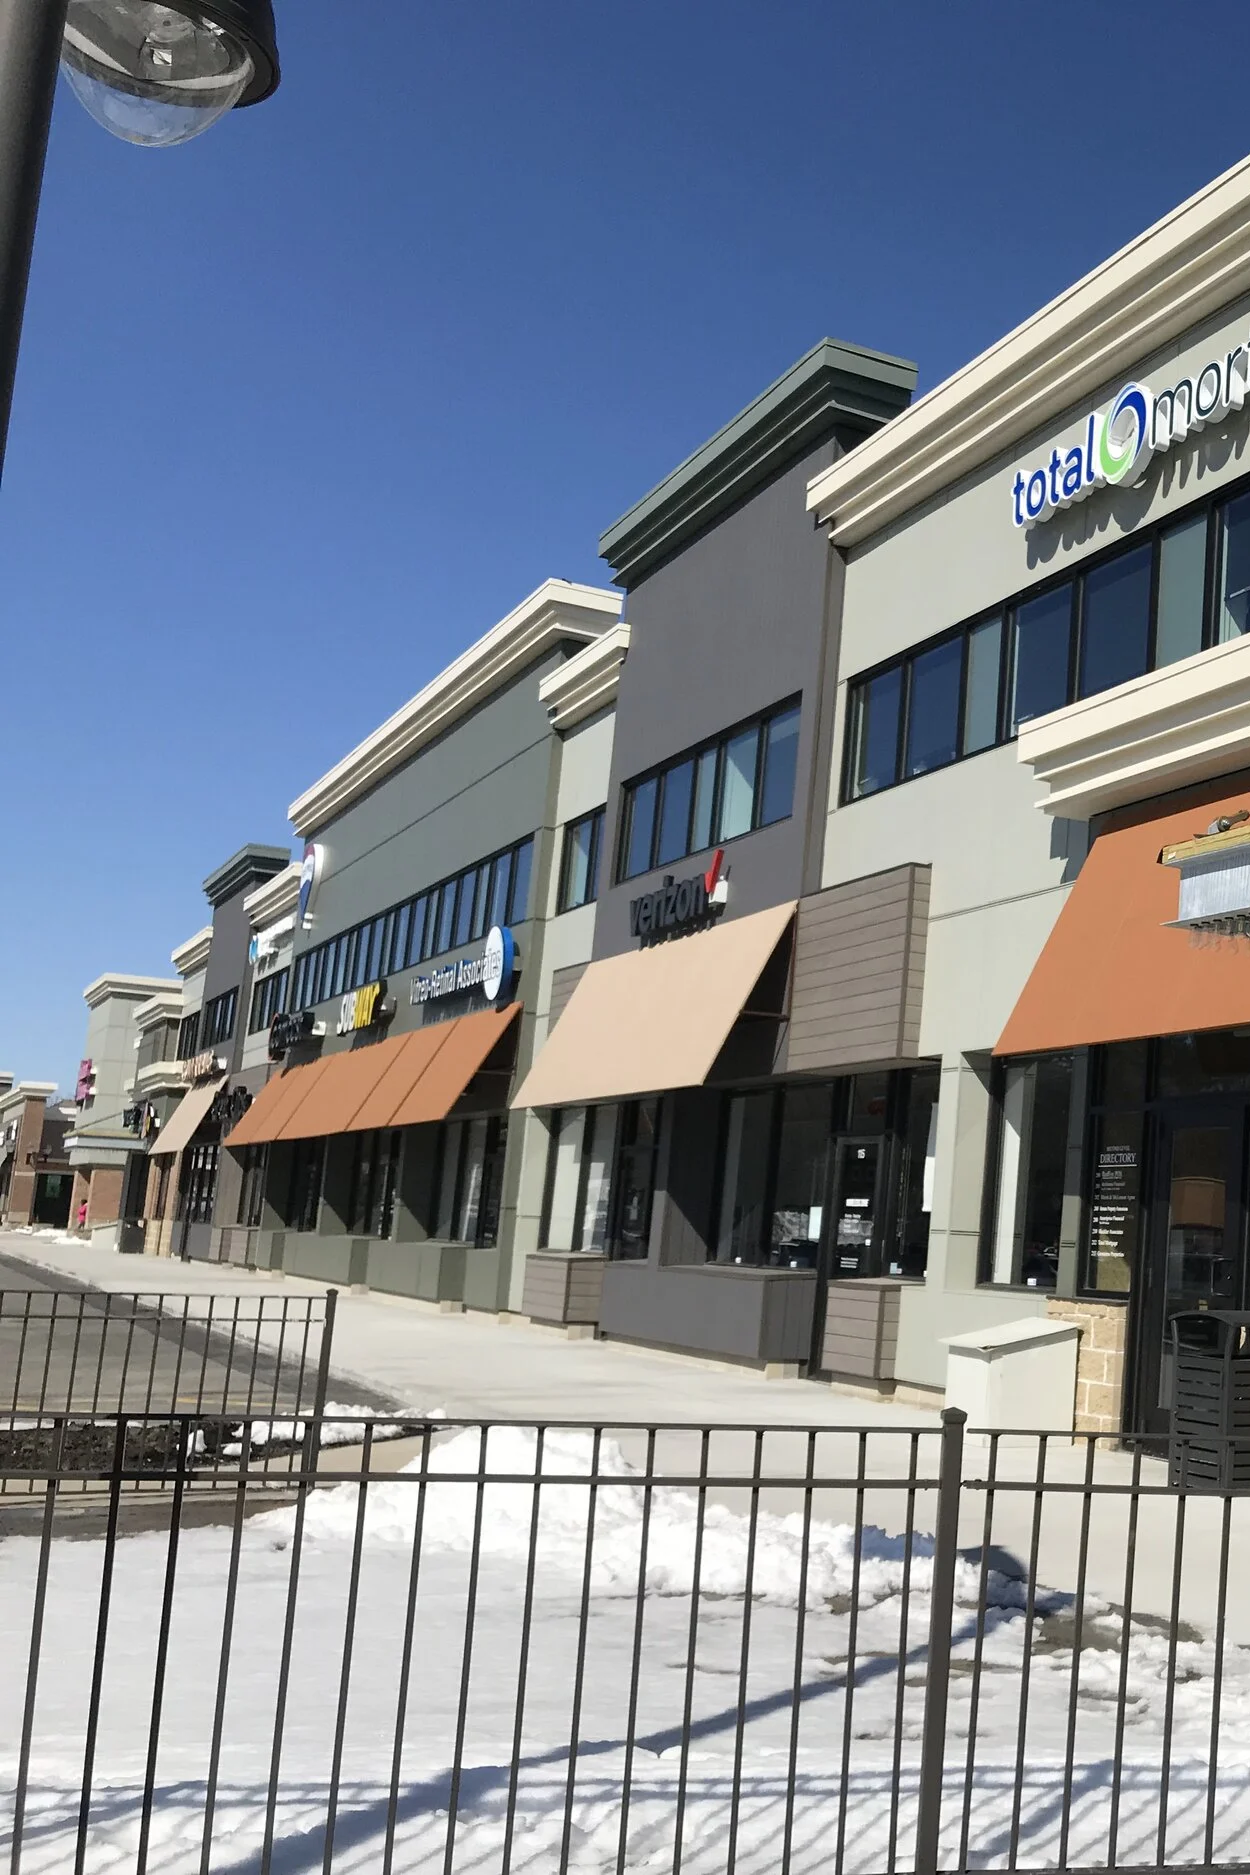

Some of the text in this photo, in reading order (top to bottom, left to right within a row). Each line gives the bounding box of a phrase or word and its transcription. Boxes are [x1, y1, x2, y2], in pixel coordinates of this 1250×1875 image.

[1010, 414, 1095, 528] total
[630, 874, 708, 936] verizon
[457, 948, 502, 990] Associates
[337, 983, 381, 1035] SUBWAY
[1100, 1153, 1137, 1163] DIRECTORY
